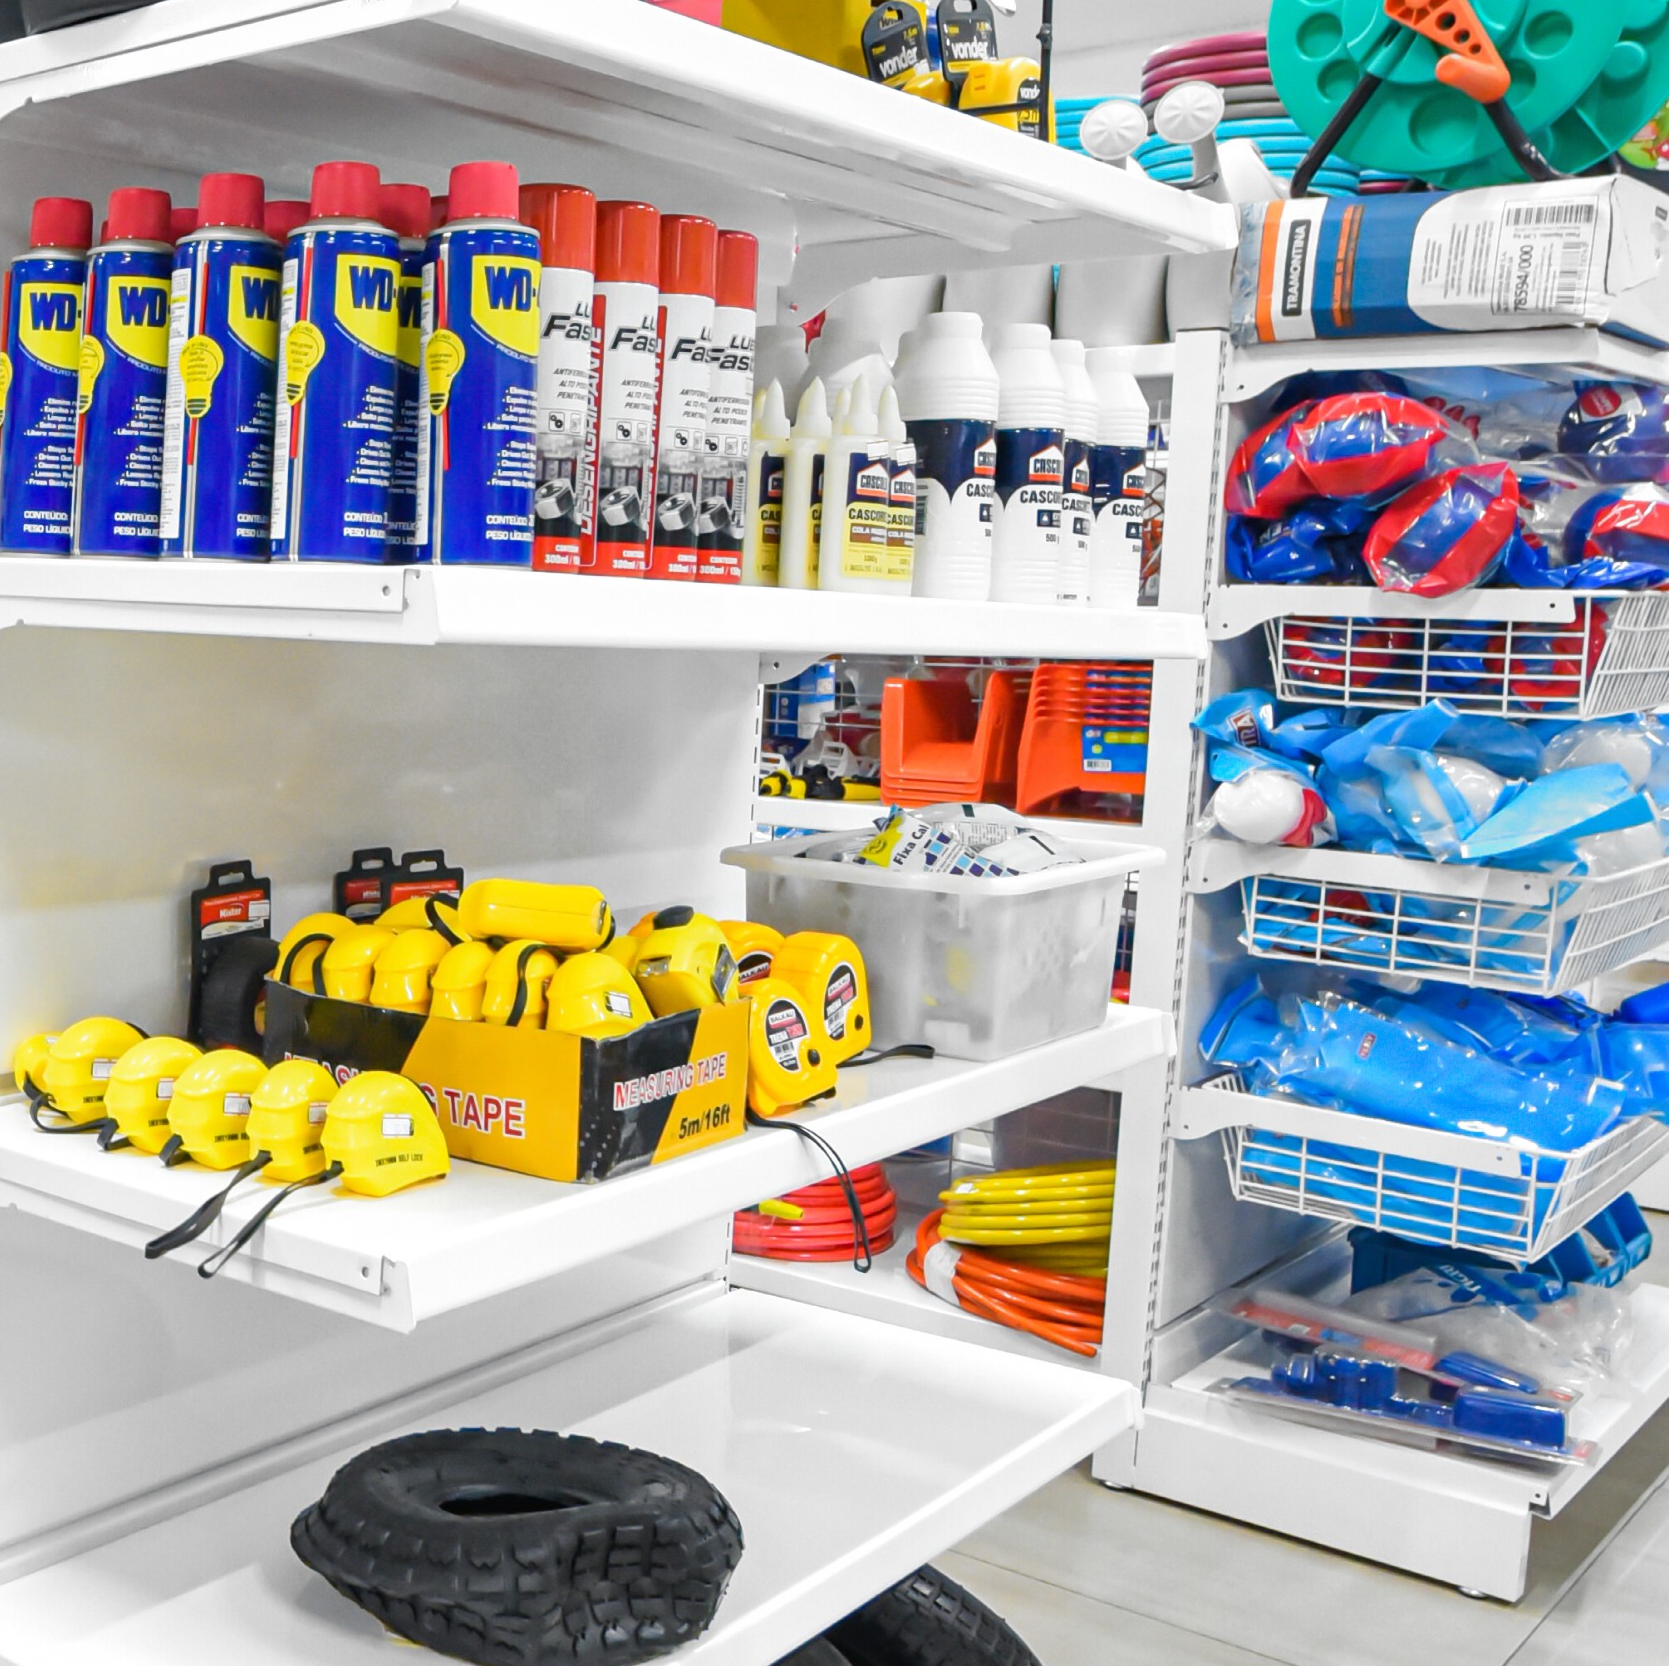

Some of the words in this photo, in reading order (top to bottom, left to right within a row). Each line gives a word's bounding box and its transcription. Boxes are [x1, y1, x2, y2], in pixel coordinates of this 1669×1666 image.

[879, 45, 918, 79] vonder
[951, 36, 989, 60] vonder
[1287, 224, 1308, 311] TRAMONTINA
[1514, 244, 1534, 312] 78594/000
[543, 313, 592, 342] Fas
[609, 326, 656, 352] Fas
[670, 337, 712, 363] Fas
[711, 346, 753, 371] Fas
[23, 524, 44, 534] PESO
[45, 522, 71, 535] LÍQUID
[893, 837, 917, 866] Fixa
[911, 824, 931, 841] Cal
[738, 962, 769, 981] ALKAU
[770, 1011, 795, 1023] BALKAU
[613, 1060, 695, 1111] MEASURING
[696, 1051, 729, 1086] TAPE
[442, 1086, 527, 1140] TAPE
[678, 1103, 731, 1140] 5m/16ft
